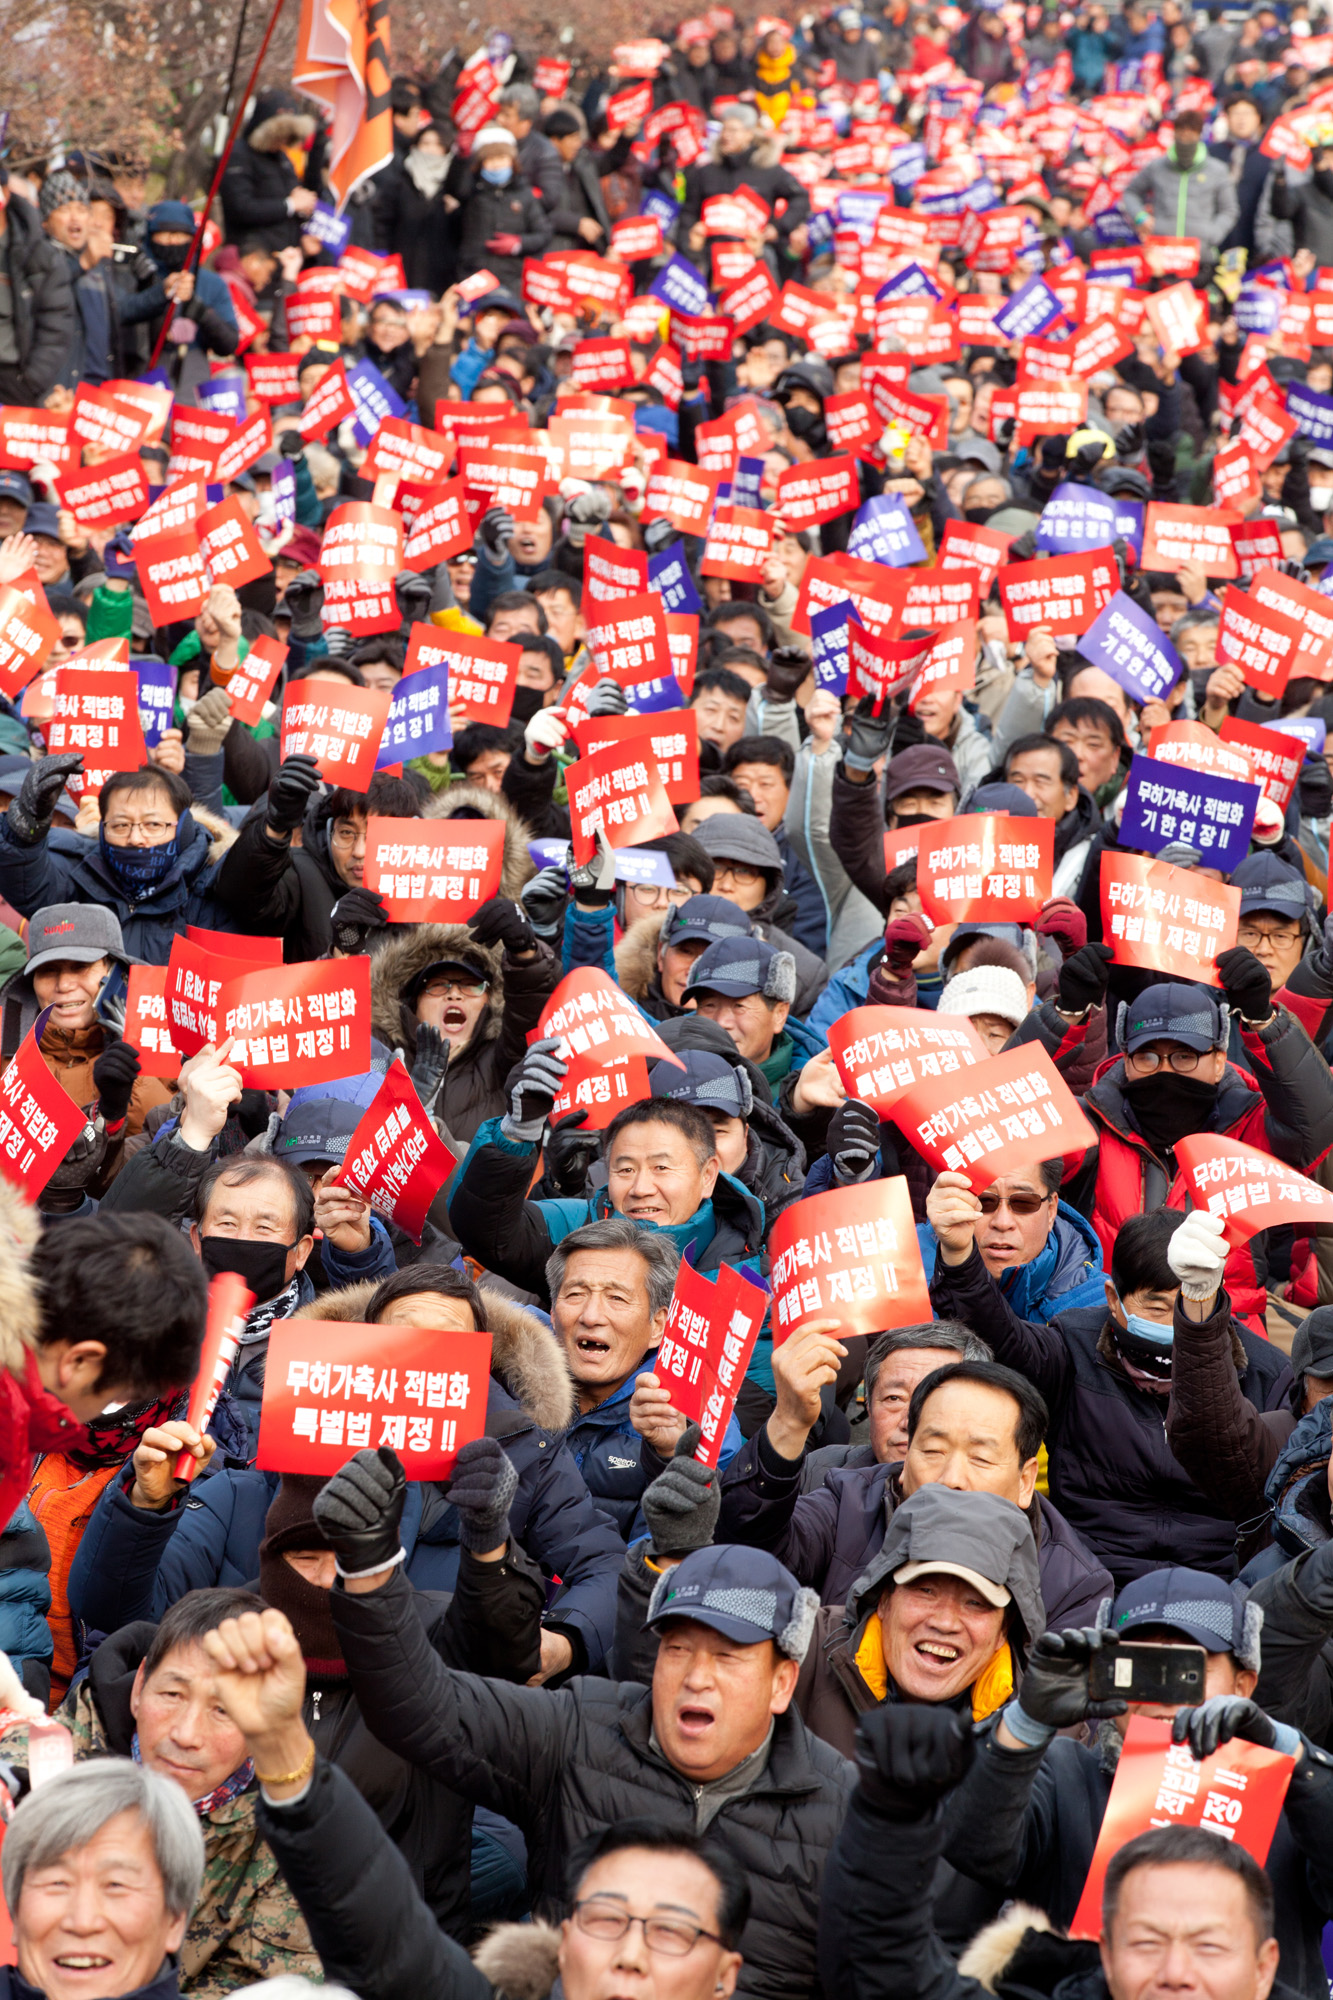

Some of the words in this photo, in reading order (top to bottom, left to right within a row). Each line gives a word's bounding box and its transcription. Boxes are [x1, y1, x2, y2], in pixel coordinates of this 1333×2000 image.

[616, 616, 656, 642] 적법화
[242, 653, 272, 682] 적법화
[472, 655, 508, 683] 적법화
[611, 644, 642, 669] 제정
[82, 695, 125, 720] 적법화
[140, 684, 174, 708] 적법화
[408, 686, 439, 713] 적법화
[457, 679, 486, 703] 제정
[70, 724, 104, 748] 제정
[285, 703, 328, 729] 무허가축사
[330, 708, 373, 739] 적법화
[309, 734, 345, 763] 제정
[1155, 741, 1215, 769] 무허가축사
[1216, 751, 1250, 776] 적법화
[575, 773, 611, 812] 무허가축사
[612, 761, 648, 793] 적법화
[1138, 780, 1201, 815] 무허가축사
[1204, 797, 1244, 827] 적법화
[607, 797, 637, 825] 제정
[376, 844, 444, 869] 무허가축사
[447, 846, 488, 871] 적법화
[929, 843, 996, 873] 무허가축사
[999, 843, 1040, 869] 적법화
[378, 874, 425, 899] 특별법
[429, 876, 463, 899] 제정
[934, 874, 982, 900] 특별법
[987, 874, 1021, 899] 제정
[1108, 882, 1180, 919] 무허가축사
[1184, 898, 1226, 932] 적법화
[43, 919, 75, 936] Sunjin
[1112, 914, 1162, 944] 특별법
[1165, 925, 1201, 955] 제정
[225, 996, 304, 1034] 무허가축사
[309, 988, 357, 1021] 적법화
[229, 1034, 289, 1067] 특별법
[297, 1027, 334, 1058] 제정
[842, 1028, 921, 1072] 무허가축사
[920, 1027, 972, 1048] 적법화
[856, 1058, 916, 1098] 특별법
[917, 1050, 960, 1077] 제정
[20, 1093, 58, 1152] 적법화
[916, 1090, 1000, 1148] 무허가축사
[995, 1071, 1052, 1107] 적법화
[375, 1102, 411, 1158] 특별법
[942, 1123, 1004, 1172] 특별법
[1000, 1106, 1046, 1142] 제정
[352, 1144, 379, 1187] 제정
[382, 1127, 428, 1196] 무허가축사
[1193, 1157, 1286, 1191] 무허가축사
[1207, 1182, 1270, 1218] 특별법
[1277, 1183, 1323, 1203] 제정
[772, 1232, 832, 1293] 무허가축사
[835, 1217, 898, 1258] 적법화
[778, 1277, 822, 1326] 특별법
[826, 1265, 878, 1303] 제정
[658, 1335, 689, 1377] 제정
[718, 1309, 752, 1388] 특별법
[287, 1359, 398, 1404] 무허가축사
[405, 1371, 470, 1410] 적법화
[292, 1406, 372, 1448] 특별법
[379, 1414, 434, 1452] 제정
[608, 1456, 636, 1469] speedo
